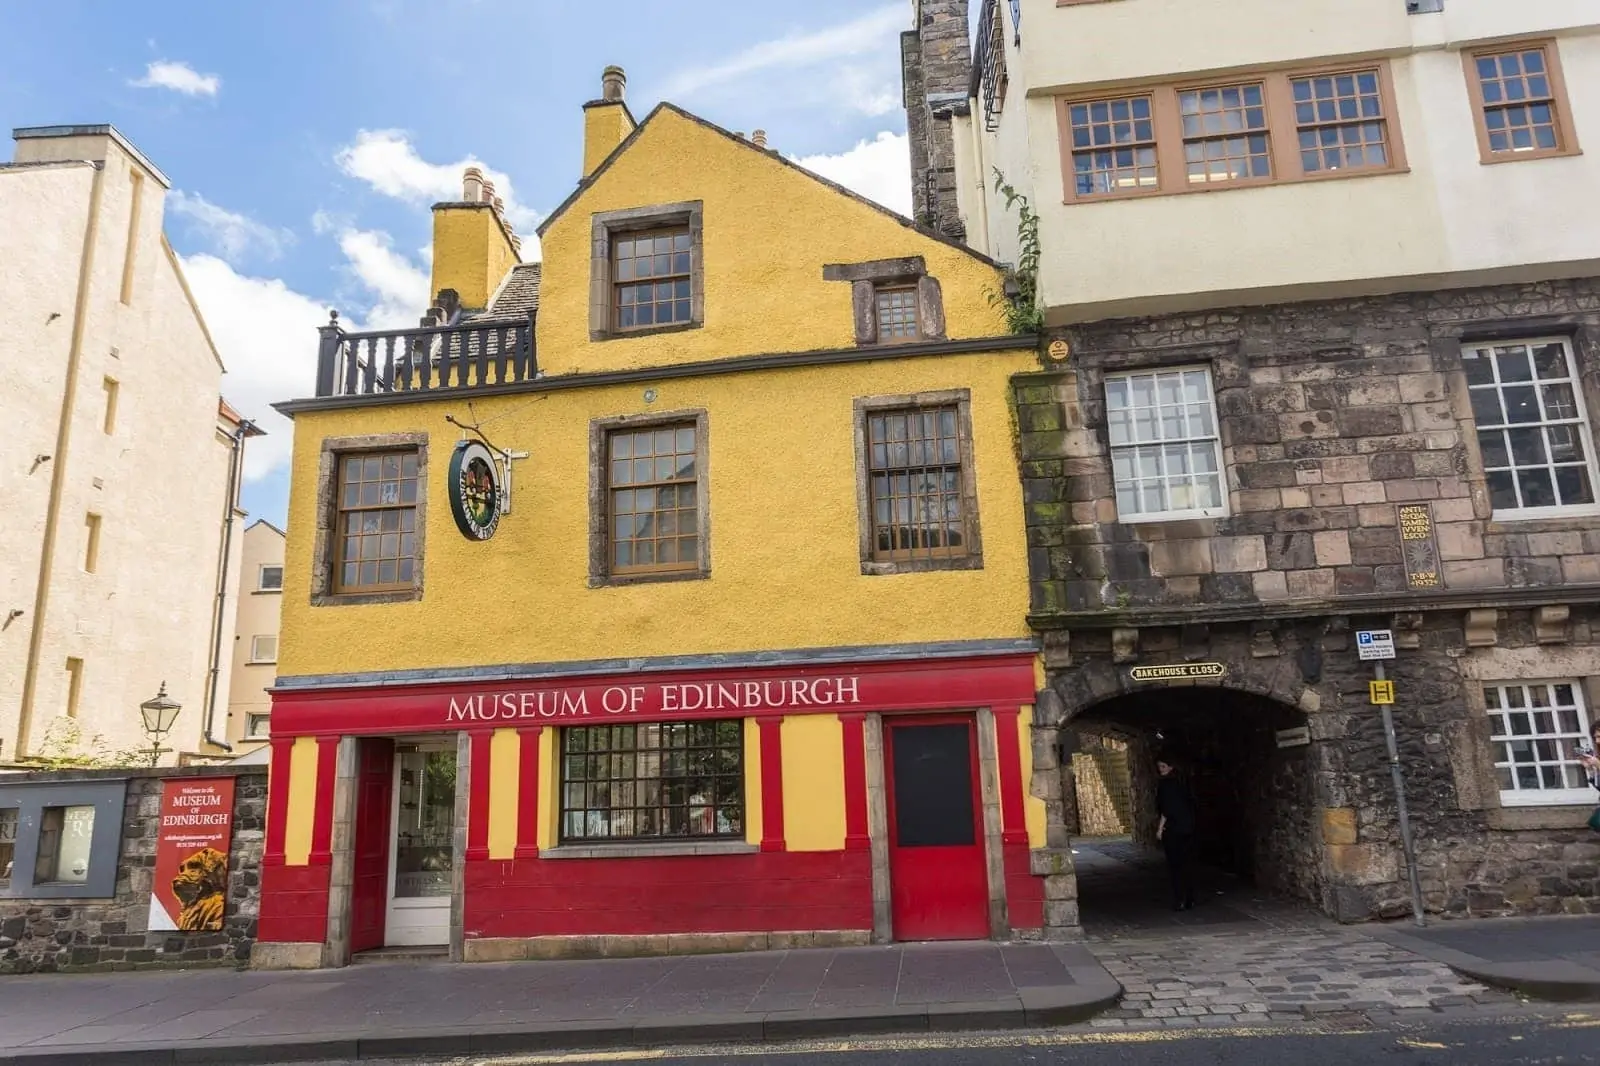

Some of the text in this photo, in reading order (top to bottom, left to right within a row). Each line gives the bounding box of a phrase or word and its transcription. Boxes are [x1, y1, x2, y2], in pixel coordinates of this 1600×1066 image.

[1361, 633, 1370, 643] P
[1135, 665, 1219, 678] BAKEHOUSE CLOSE
[1373, 682, 1391, 702] H
[446, 676, 861, 722] MUSEUM OF EDINBURGH
[172, 795, 221, 806] MUSEUM
[163, 814, 228, 825] EDINBURGH
